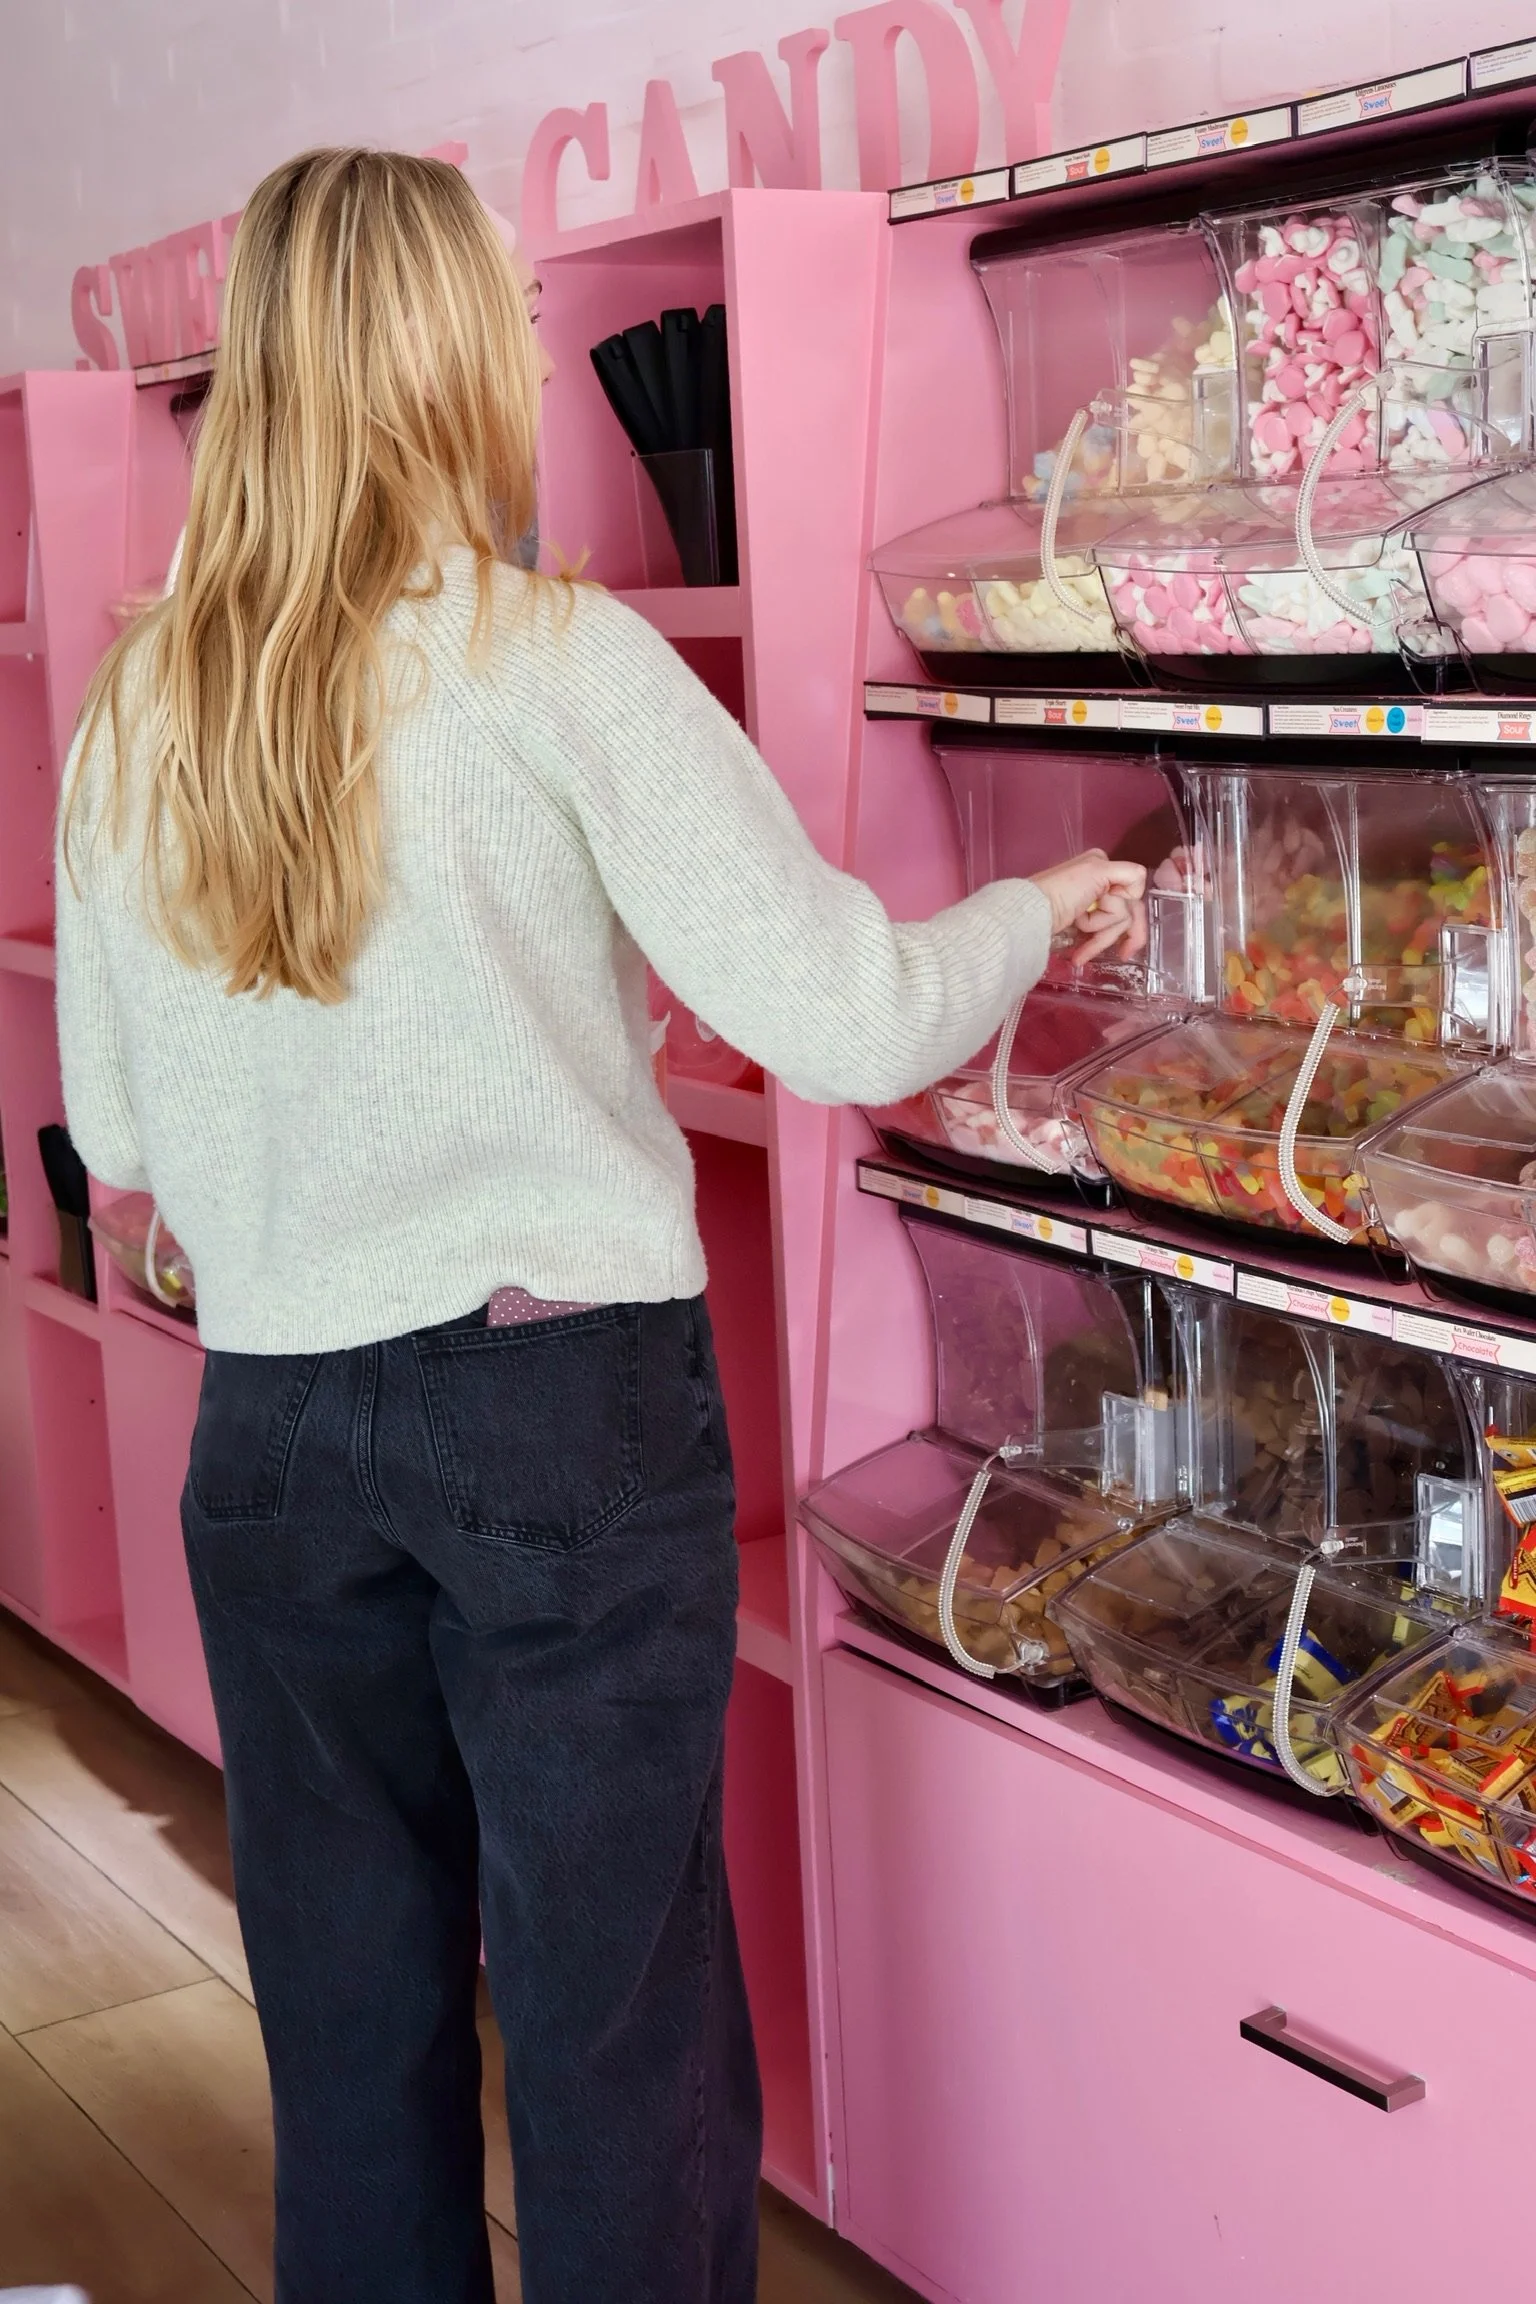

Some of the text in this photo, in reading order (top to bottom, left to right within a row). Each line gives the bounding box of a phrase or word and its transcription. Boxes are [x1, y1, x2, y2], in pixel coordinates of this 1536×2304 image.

[1363, 97, 1388, 111] Sweet
[521, 0, 1071, 234] CANDY
[1201, 136, 1224, 149] Sweet
[1069, 165, 1085, 176] Sour
[1047, 710, 1063, 721] Sour
[1176, 715, 1198, 726] Sweet
[1497, 711, 1532, 720] Diamond Rings
[1333, 718, 1358, 729] Sweet
[1503, 724, 1525, 735] Sour
[1143, 1256, 1172, 1271] Chocolate
[1292, 1299, 1325, 1313] Chocolate
[1458, 1341, 1494, 1357] Chocolate
